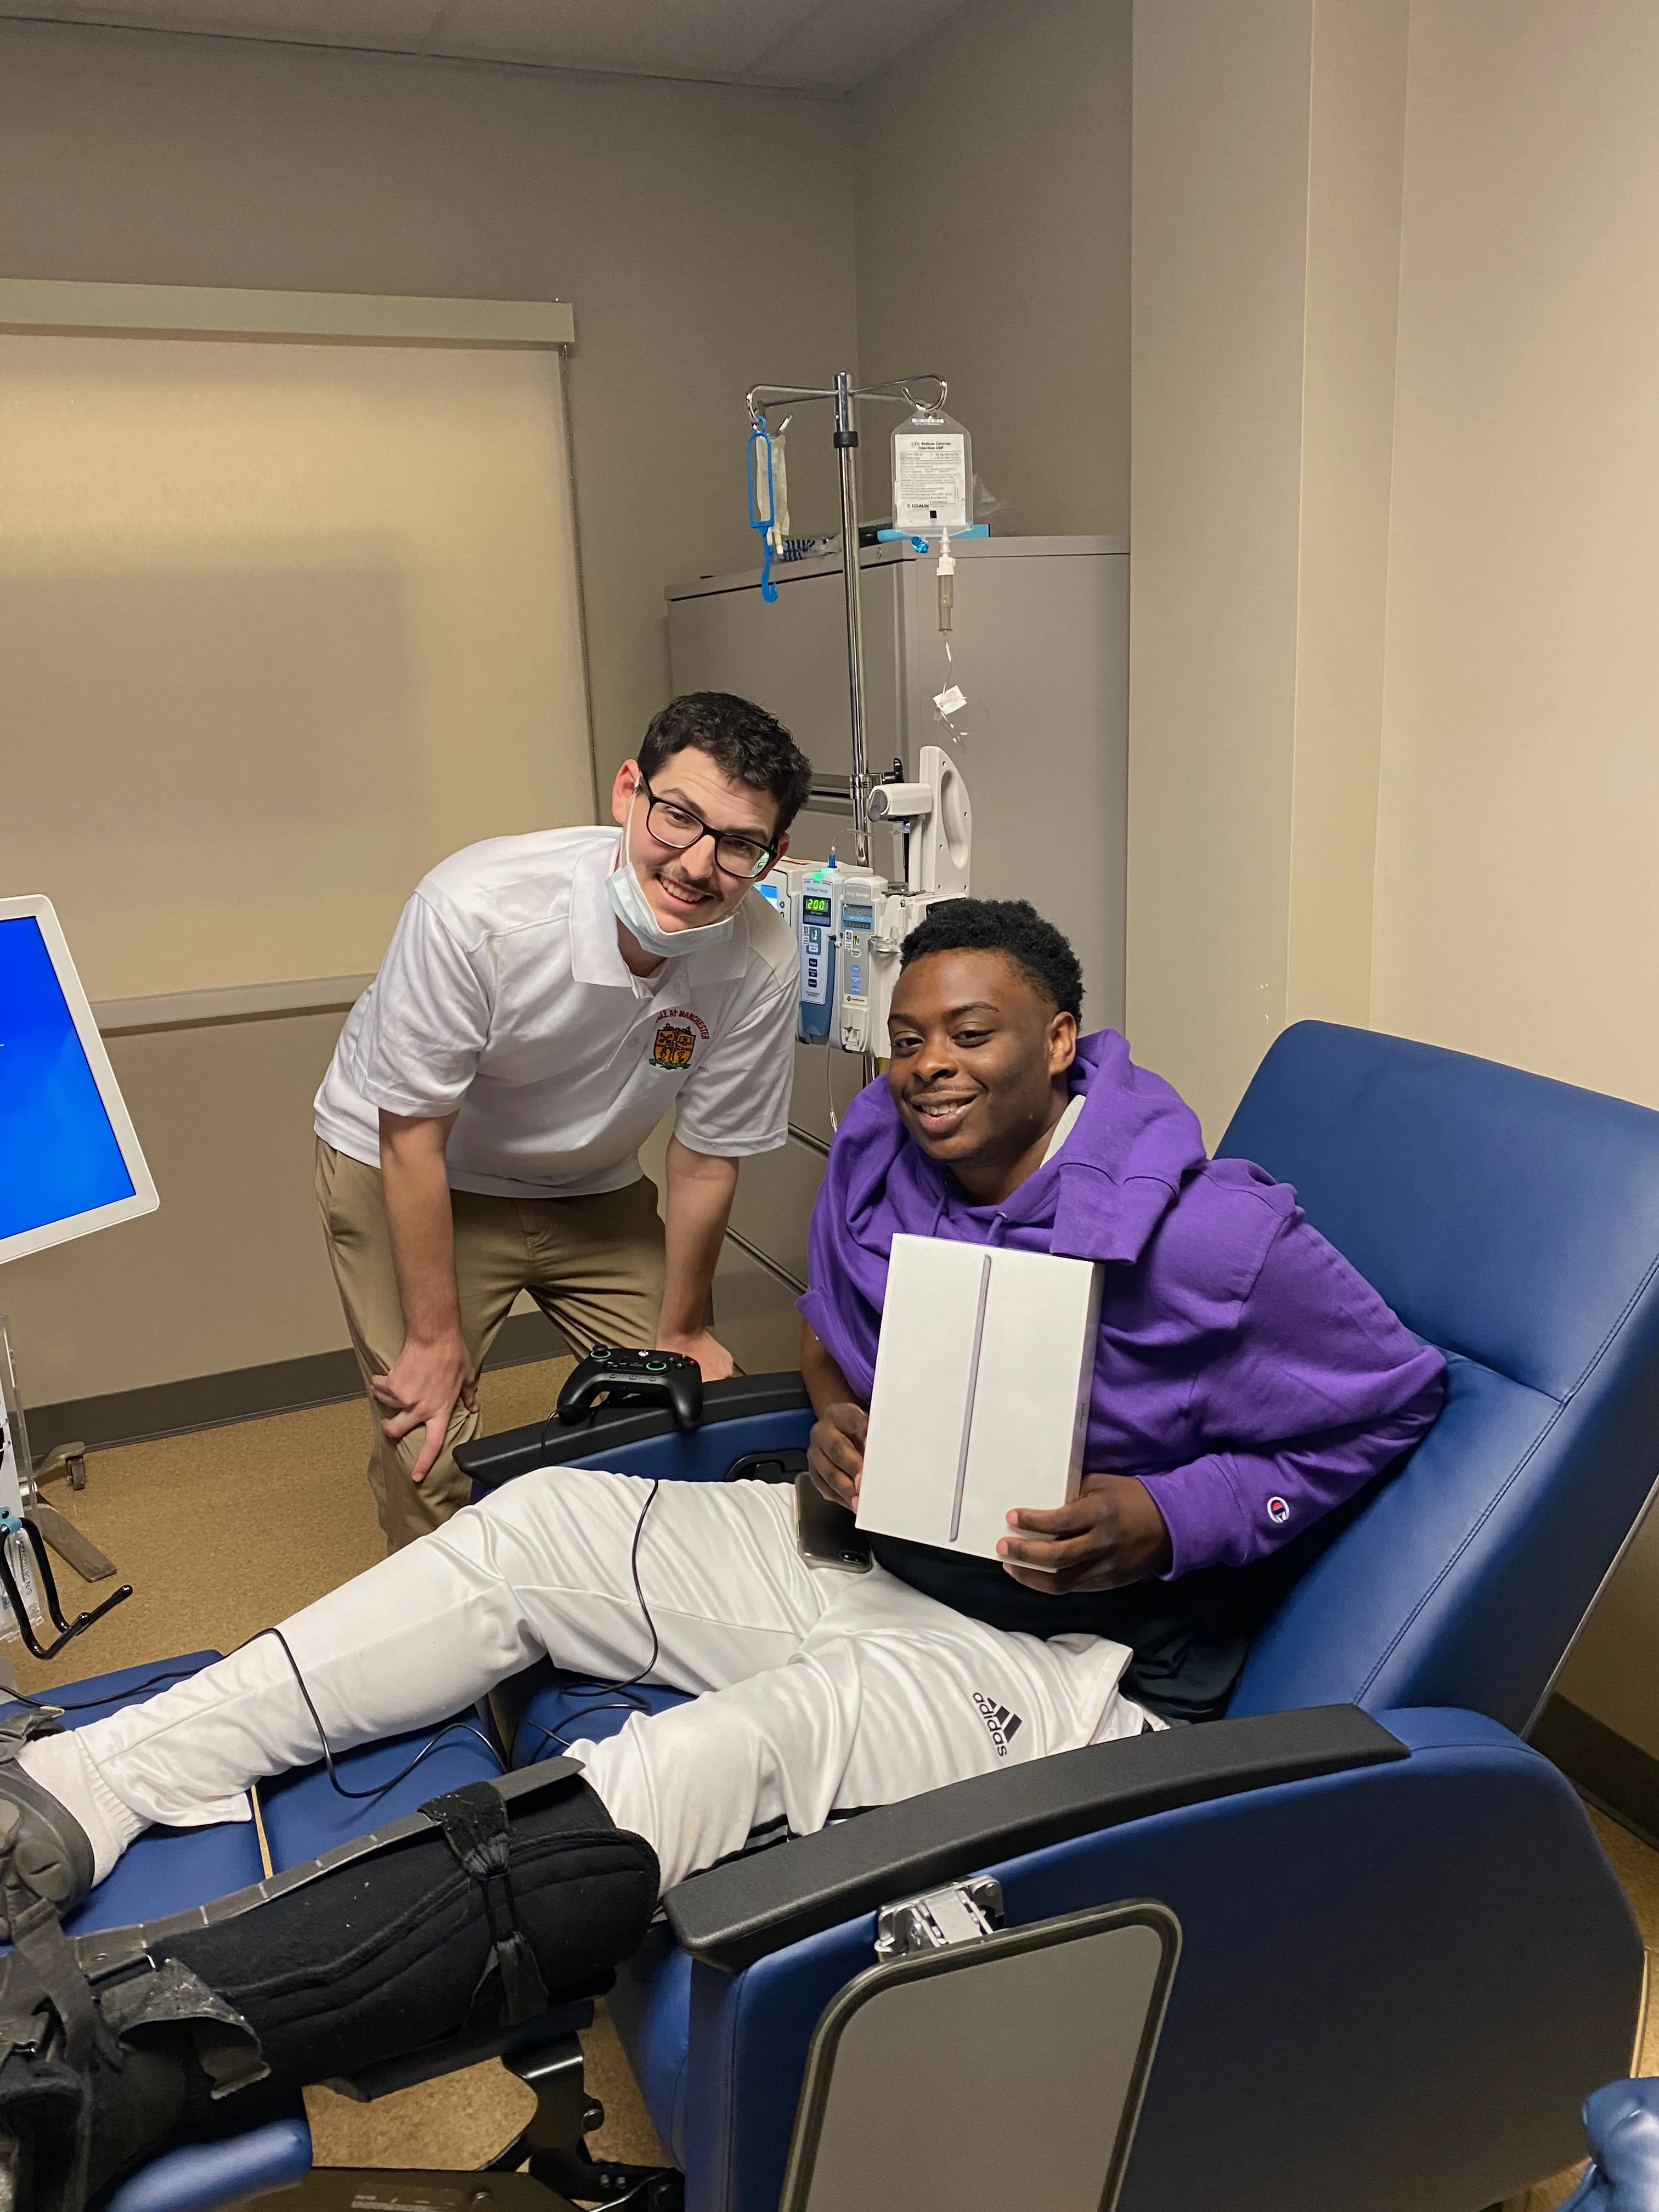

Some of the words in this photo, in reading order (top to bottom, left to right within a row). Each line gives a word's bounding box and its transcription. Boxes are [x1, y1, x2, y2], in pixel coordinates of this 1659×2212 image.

[807, 899, 825, 911] 200
[679, 1010, 710, 1039] MANCHESTER
[972, 1692, 1007, 1757] adidas
